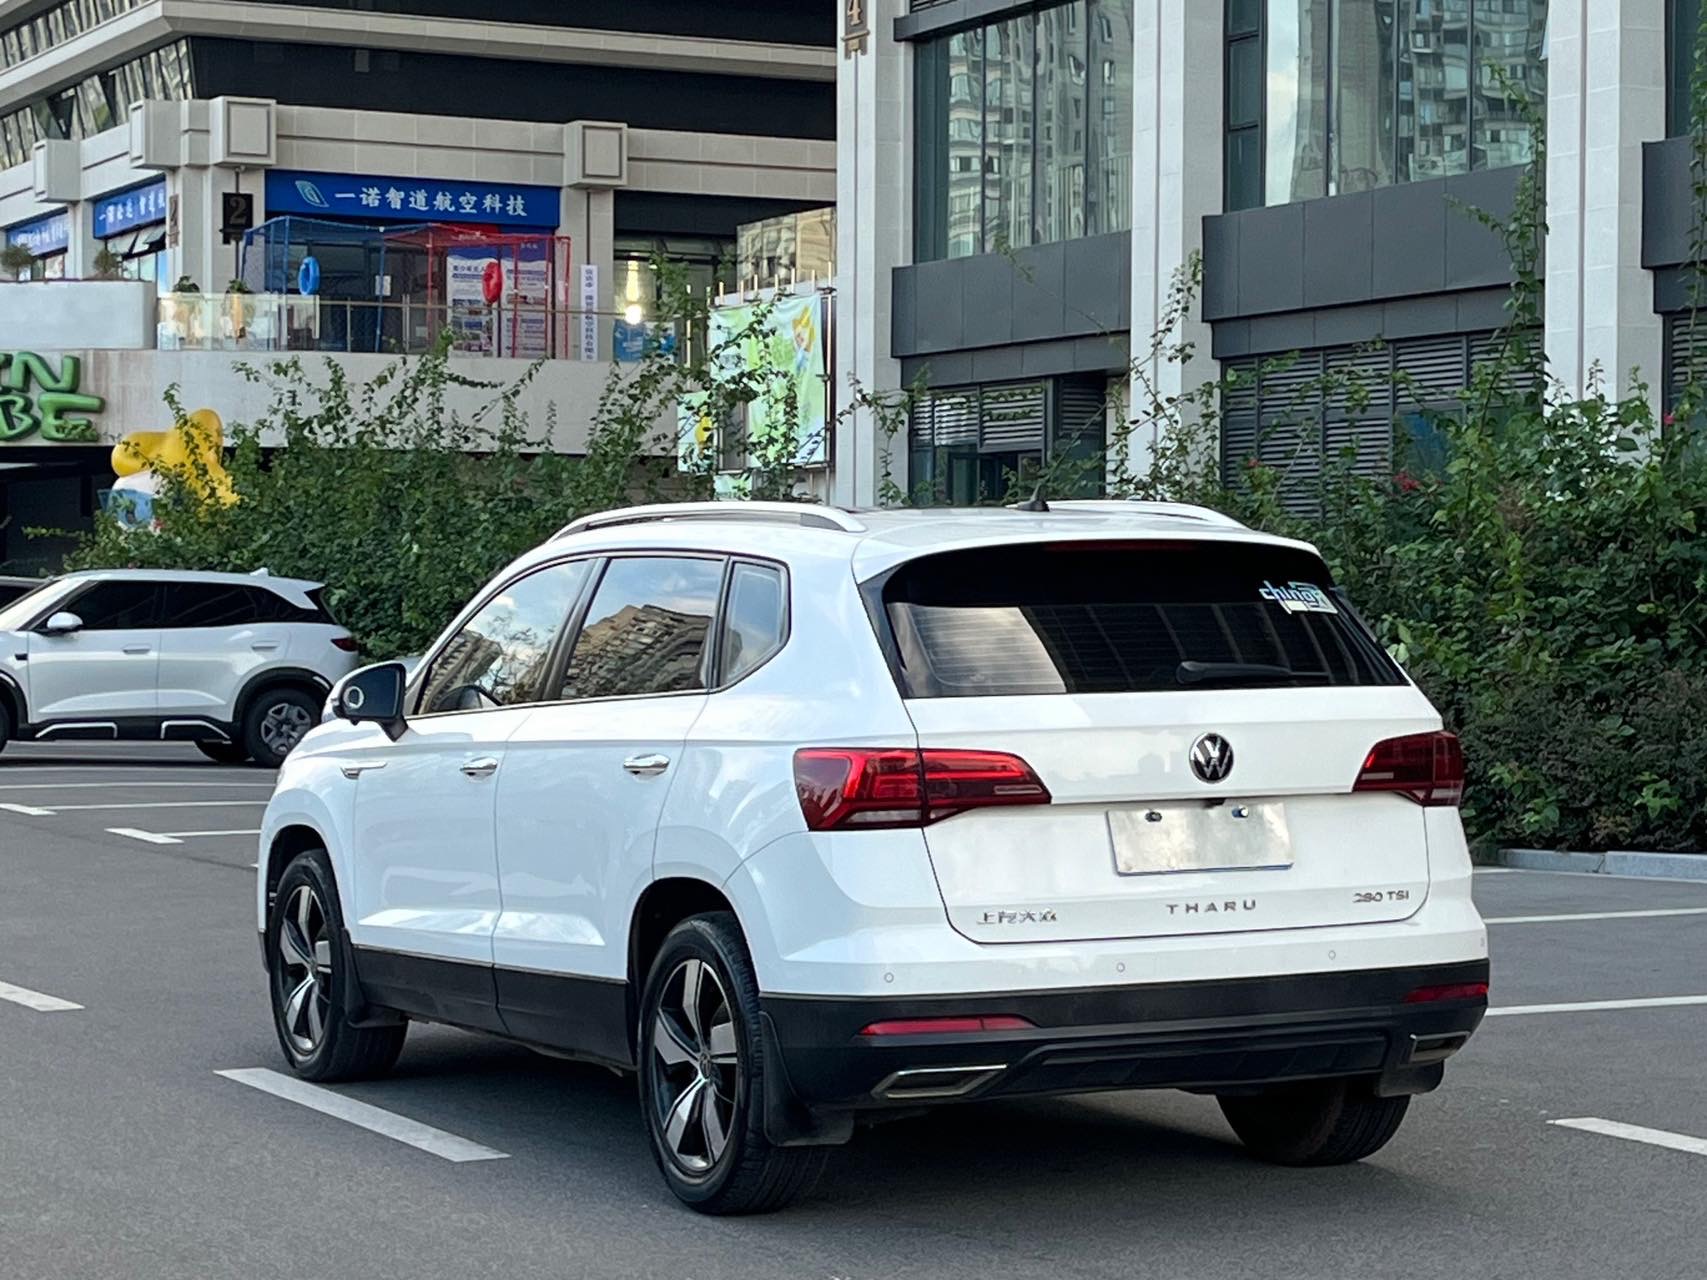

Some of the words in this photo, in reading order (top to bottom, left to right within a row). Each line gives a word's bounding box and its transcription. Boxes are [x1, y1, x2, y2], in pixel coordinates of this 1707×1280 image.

[848, 0, 863, 26] 4
[229, 196, 248, 224] 2
[334, 186, 528, 216] 一诺智道航空科技
[1166, 899, 1257, 915] THARU
